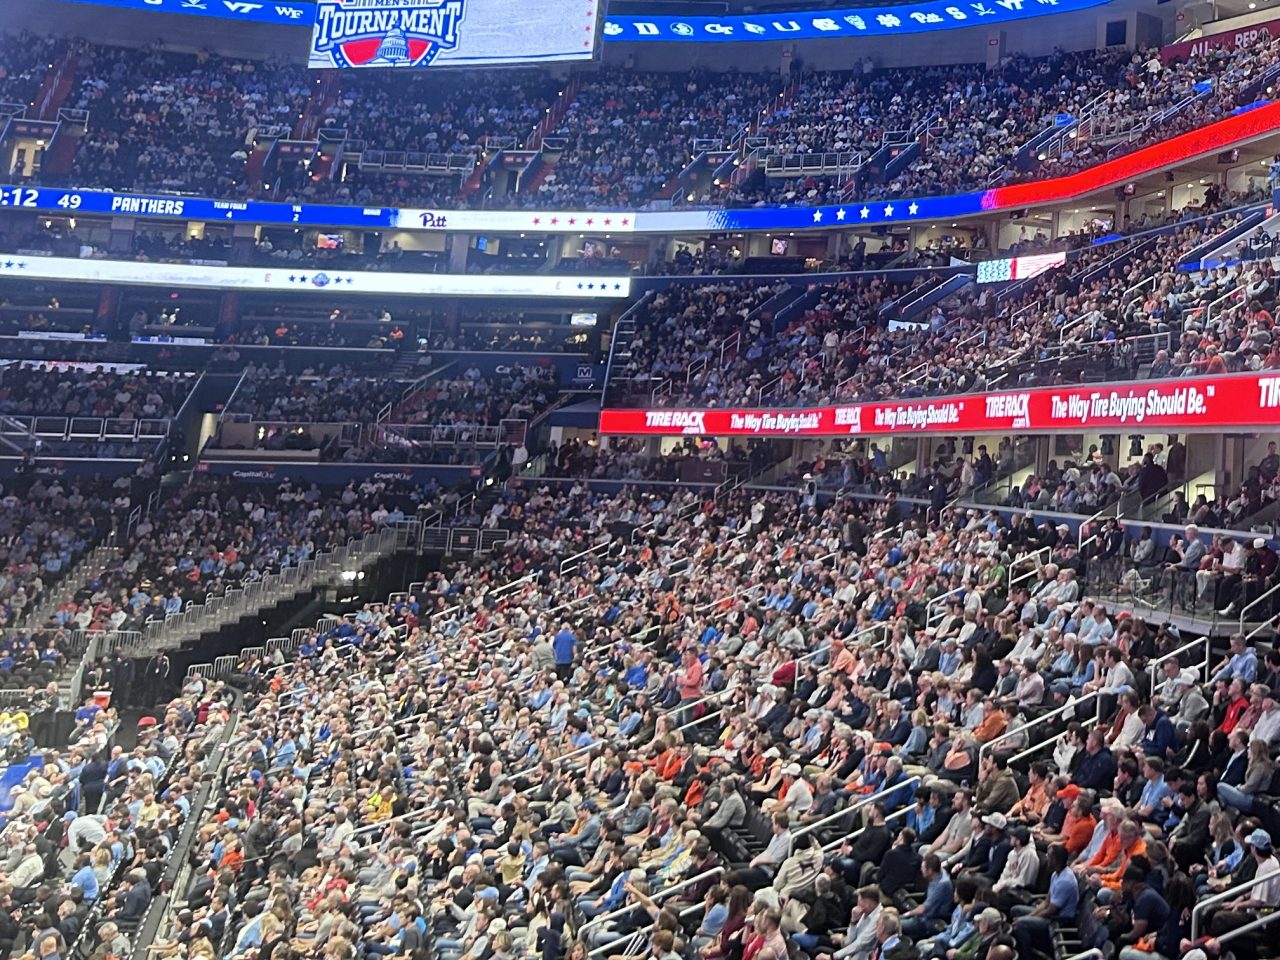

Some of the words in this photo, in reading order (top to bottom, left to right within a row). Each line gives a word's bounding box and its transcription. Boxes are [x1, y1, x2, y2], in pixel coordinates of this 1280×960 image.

[222, 0, 264, 13] VT
[318, 1, 462, 46] TOURNAMENT
[0, 189, 39, 208] :12
[58, 194, 82, 209] 49
[112, 196, 184, 215] PANTHERS
[419, 212, 447, 228] Pitt
[874, 408, 884, 426] The
[884, 408, 897, 429] Way
[927, 404, 949, 425] Should
[1051, 395, 1067, 419] The
[1068, 395, 1090, 423] Way
[1090, 392, 1109, 416] Tire
[1109, 390, 1145, 422] Buying
[1146, 388, 1186, 415] Should
[731, 414, 743, 428] The
[743, 415, 761, 432] Way
[762, 414, 776, 429] Tire
[776, 414, 799, 432] Buying
